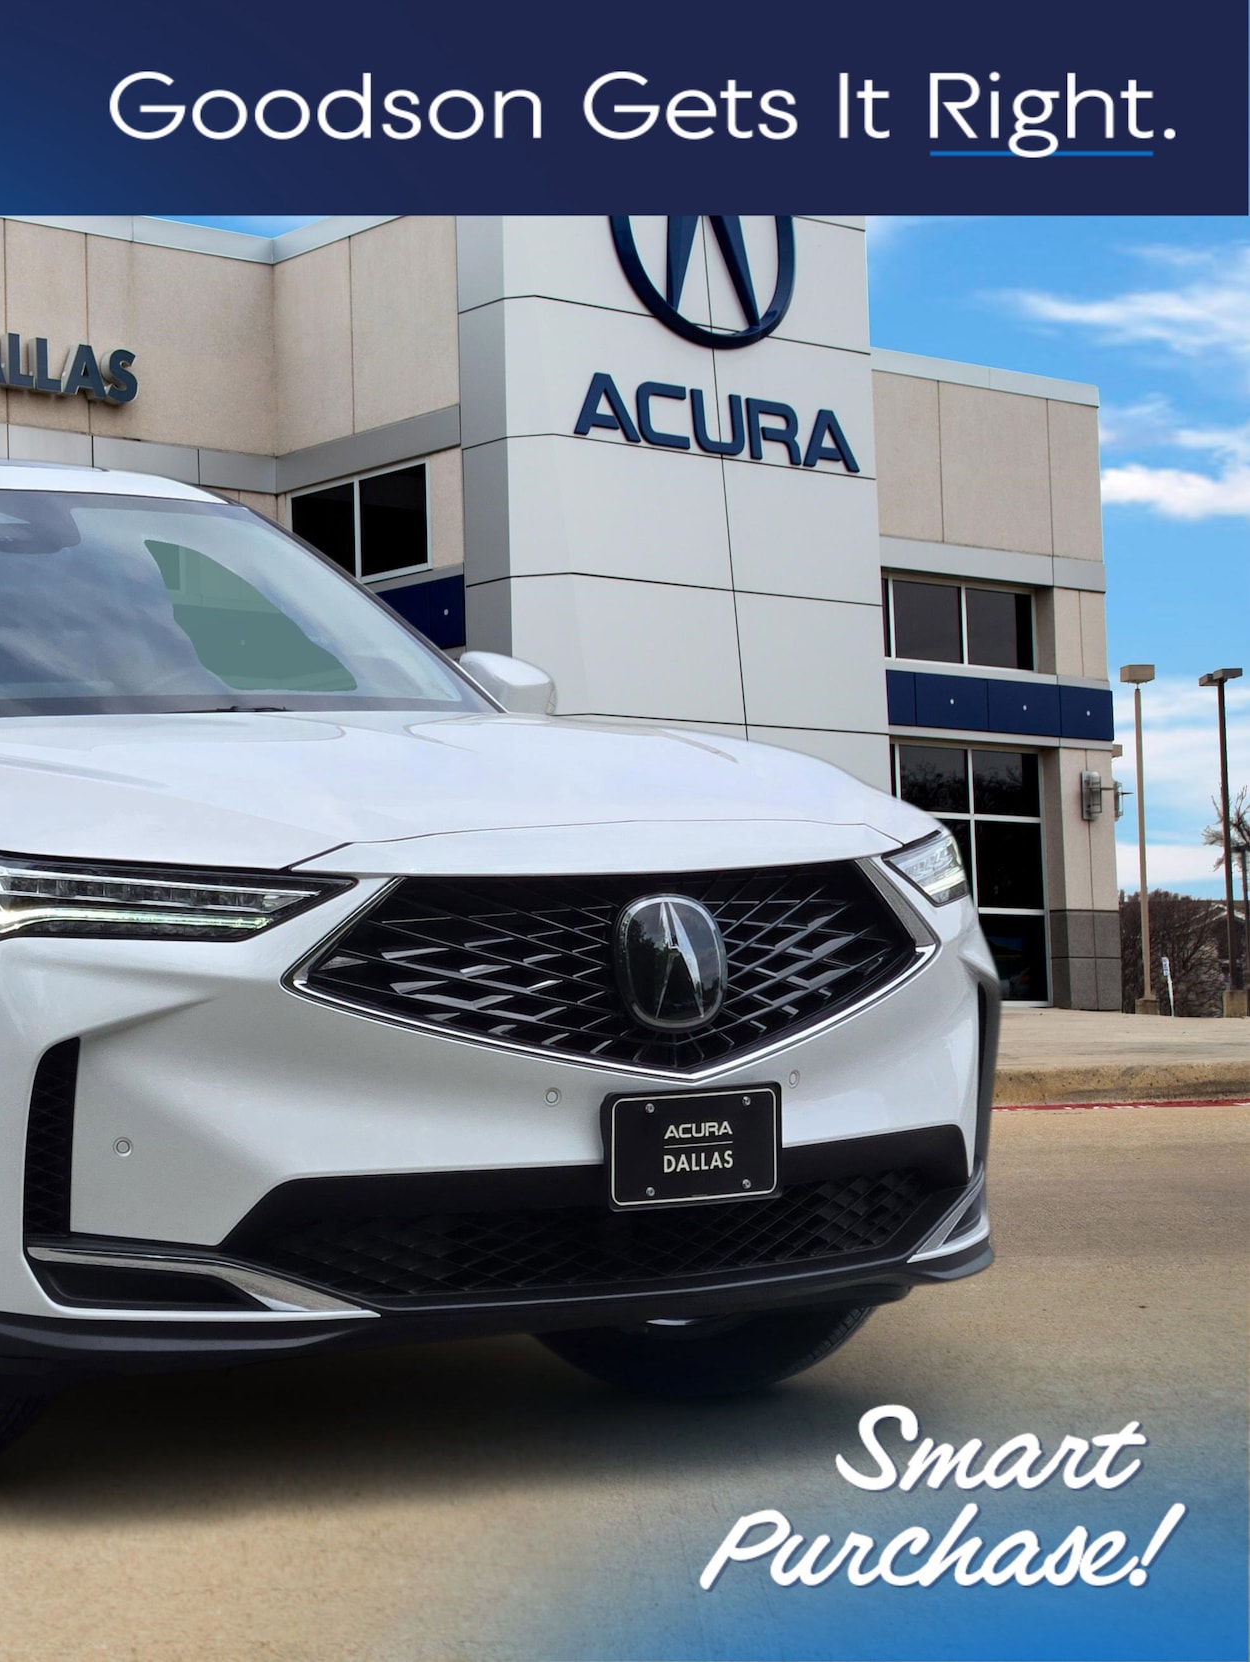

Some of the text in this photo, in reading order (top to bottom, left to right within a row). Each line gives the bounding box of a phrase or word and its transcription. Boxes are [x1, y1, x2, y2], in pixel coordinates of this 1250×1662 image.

[573, 372, 860, 473] ACURA
[664, 1121, 733, 1140] ACURA
[664, 1150, 734, 1173] DALLAS
